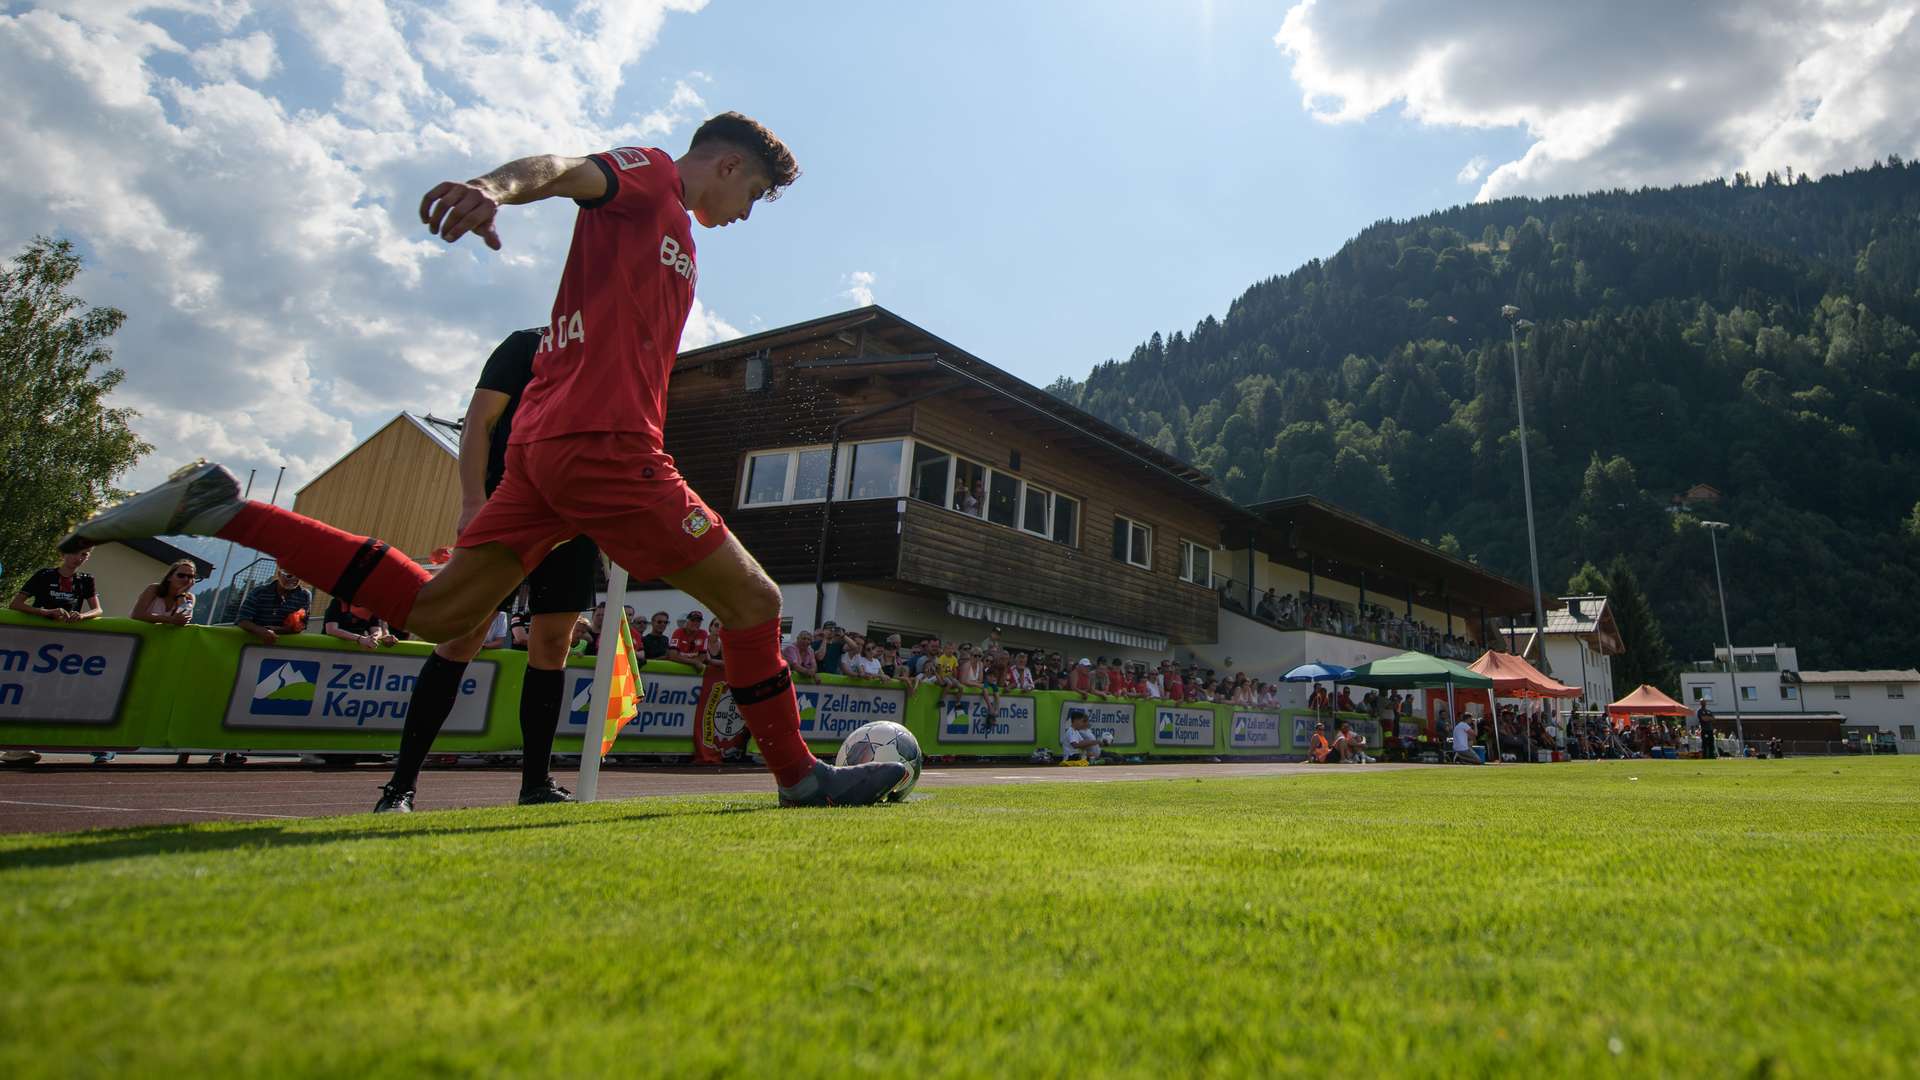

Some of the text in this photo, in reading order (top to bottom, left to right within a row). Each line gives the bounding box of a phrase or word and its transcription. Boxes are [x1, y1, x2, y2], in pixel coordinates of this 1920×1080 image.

[558, 309, 585, 349] 04
[32, 643, 107, 676] See
[327, 664, 385, 691] Zell
[660, 690, 687, 705] am
[822, 694, 897, 714] Zell am See
[322, 692, 407, 726] Kapru
[1010, 704, 1029, 719] See
[1088, 708, 1130, 724] Zell am See
[627, 711, 684, 732] aprun
[1174, 713, 1210, 728] Zell am See
[1174, 727, 1199, 743] Kaprun
